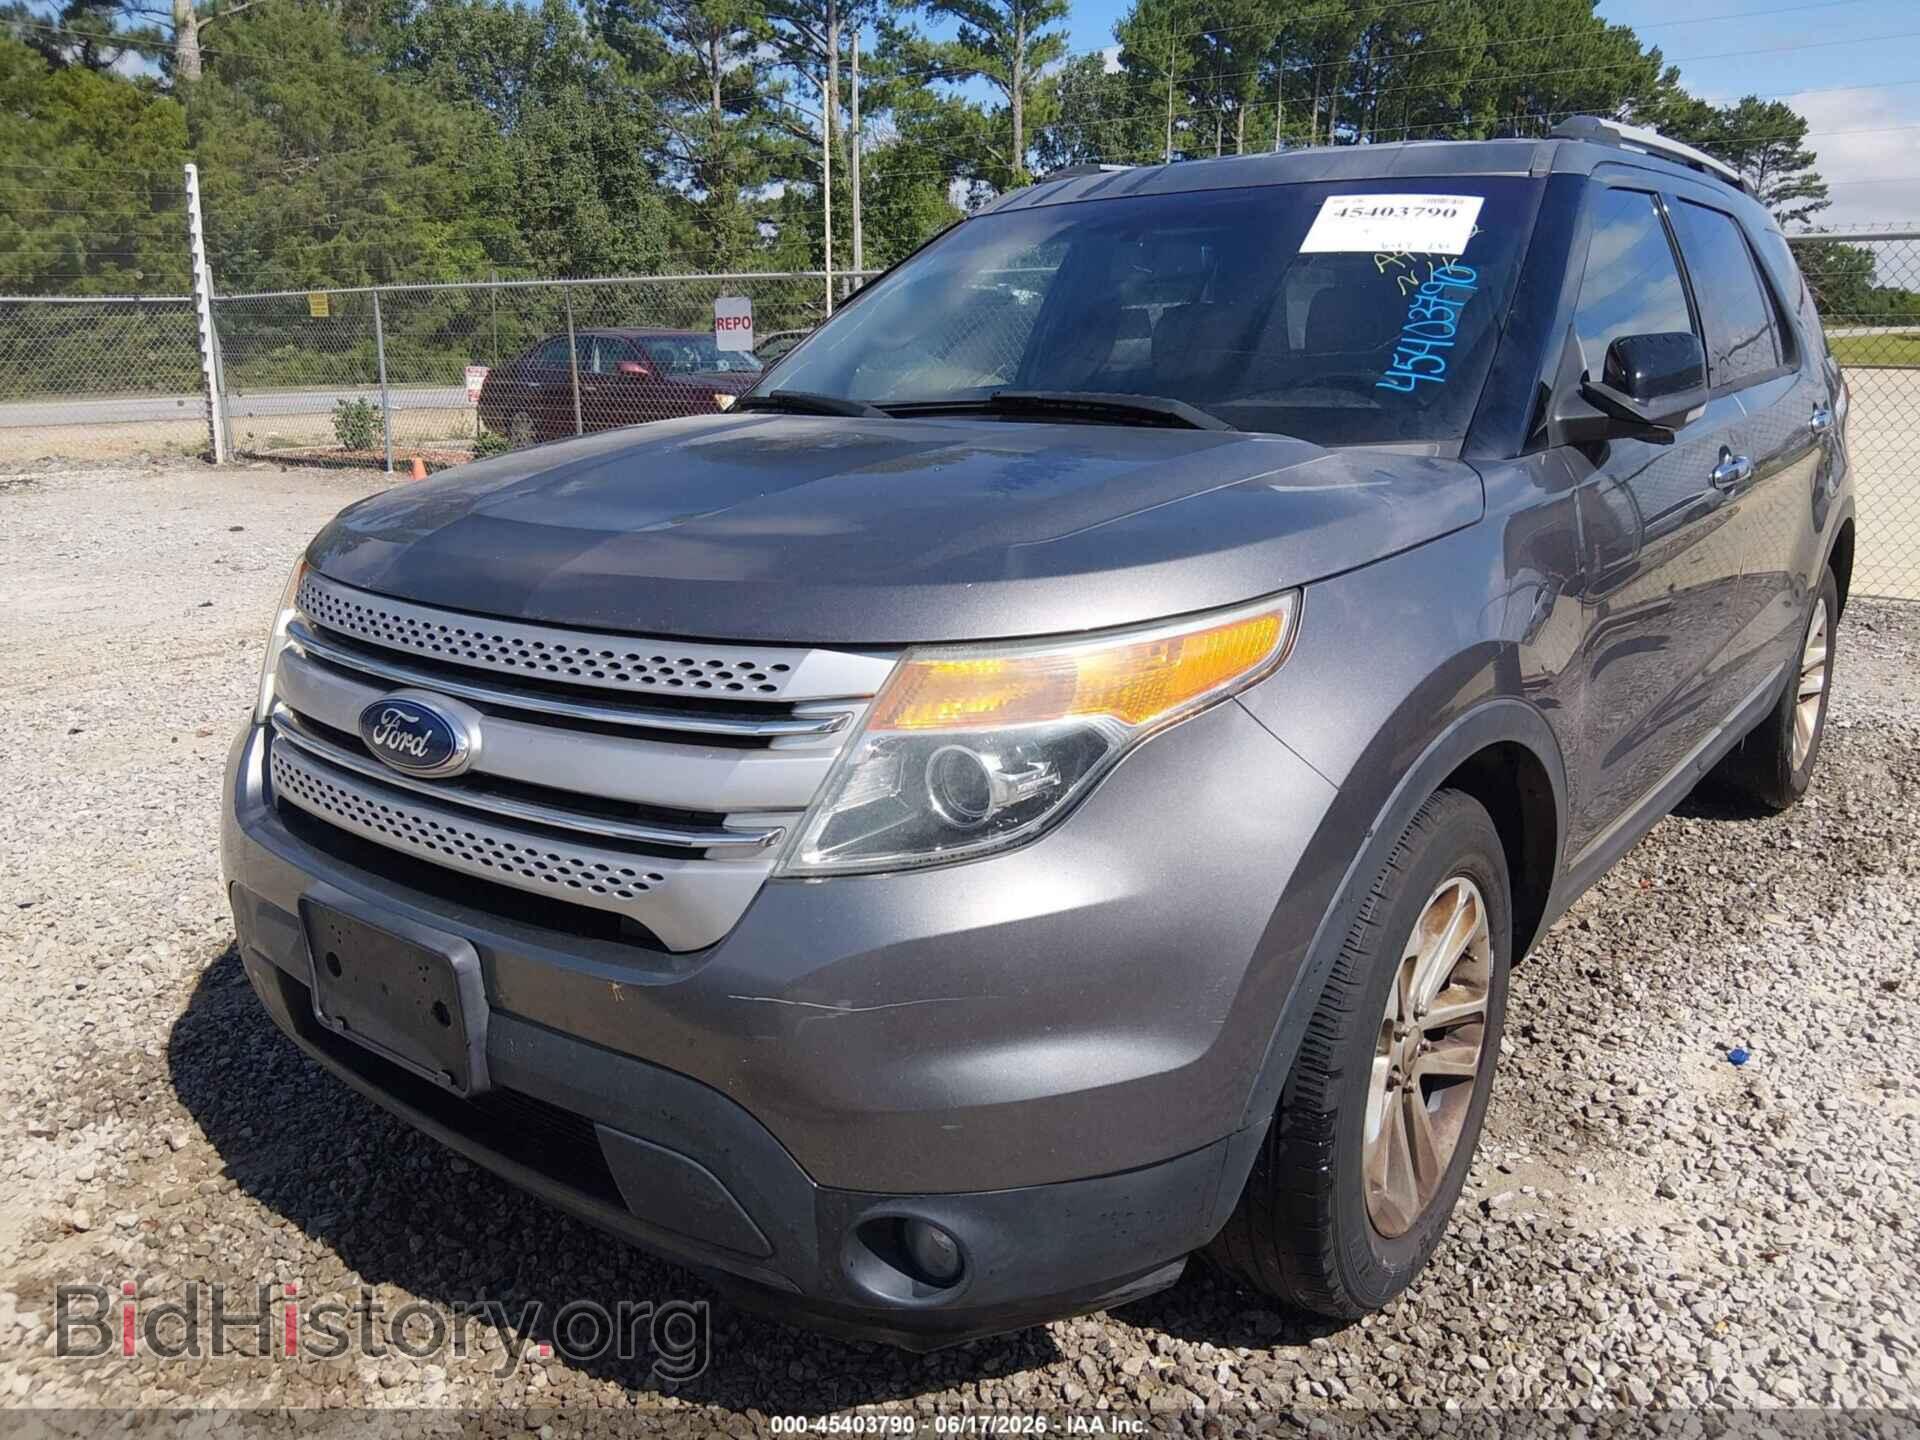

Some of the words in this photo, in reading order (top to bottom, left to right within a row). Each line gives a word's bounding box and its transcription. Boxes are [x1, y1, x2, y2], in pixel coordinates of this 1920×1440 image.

[1334, 206, 1457, 218] 45403790
[716, 316, 751, 330] REPO
[1375, 264, 1478, 391] 45403790
[373, 708, 432, 757] Ford
